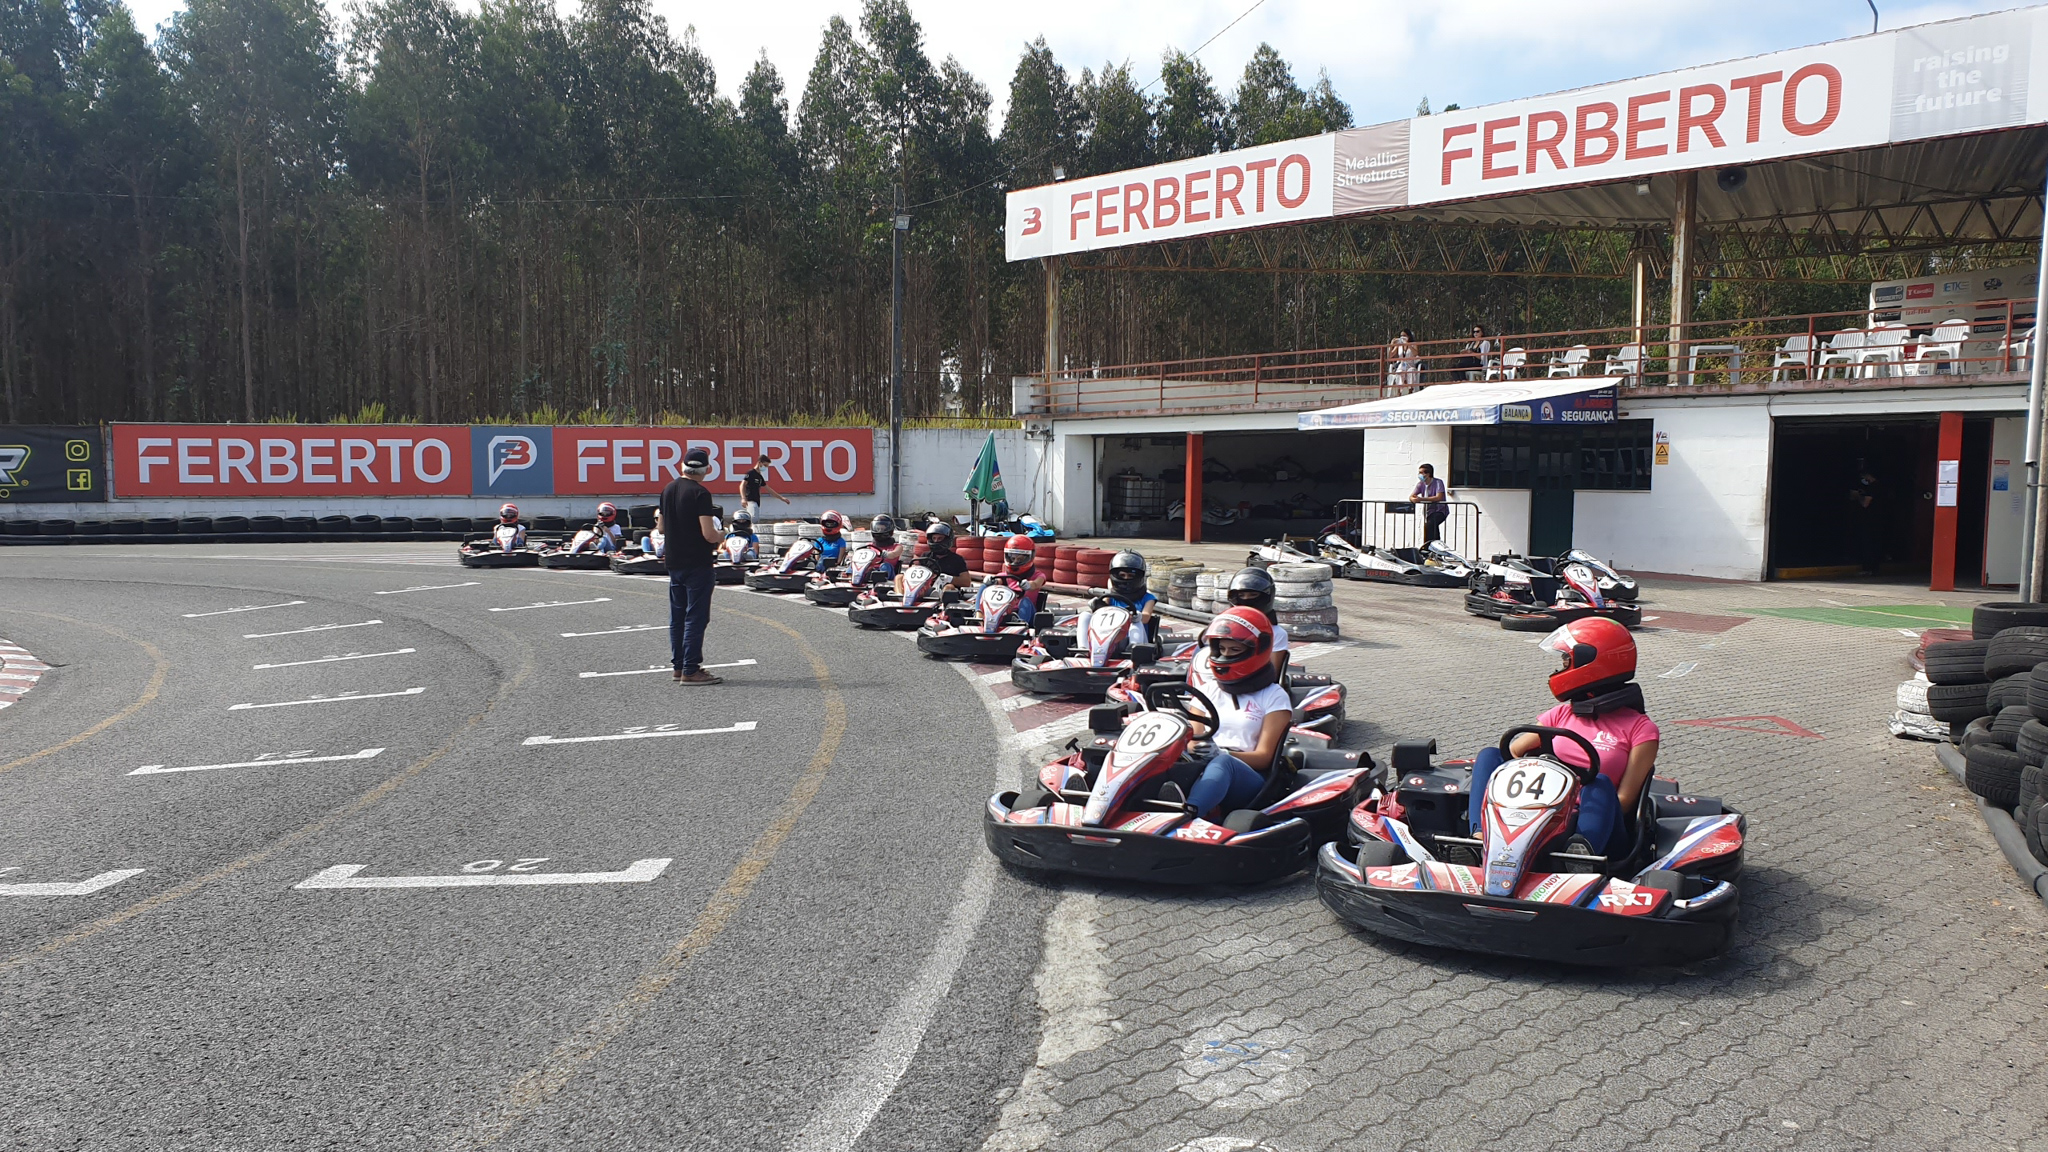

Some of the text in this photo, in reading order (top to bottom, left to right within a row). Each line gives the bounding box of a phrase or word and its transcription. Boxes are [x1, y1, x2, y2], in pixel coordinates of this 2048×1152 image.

[1913, 43, 2010, 72] raising
[1937, 68, 1982, 88] the
[1914, 86, 2003, 113] future
[1441, 62, 1842, 186] FERBERTO
[1345, 151, 1398, 172] Metallic
[1336, 167, 1406, 187] Structures
[1069, 153, 1312, 241] FERBERTO
[1386, 410, 1459, 422] SEGURANÇA
[1504, 405, 1529, 418] BALANÇA
[1561, 409, 1615, 423] SEGURANÇA
[139, 438, 451, 484] FERBERTO
[577, 439, 857, 483] FERBERTO
[858, 552, 868, 561] 73
[910, 569, 925, 579] 63
[1573, 568, 1587, 578] 74
[989, 589, 1005, 602] 75
[1100, 614, 1116, 627] 71
[1127, 724, 1162, 747] 66
[1506, 770, 1547, 800] 64
[1176, 828, 1223, 841] RX7
[463, 858, 550, 873] 20
[1367, 869, 1419, 886] RX7
[1454, 865, 1478, 895] EUROIND
[1527, 873, 1562, 903] UROINDY
[1598, 893, 1653, 908] RX7
